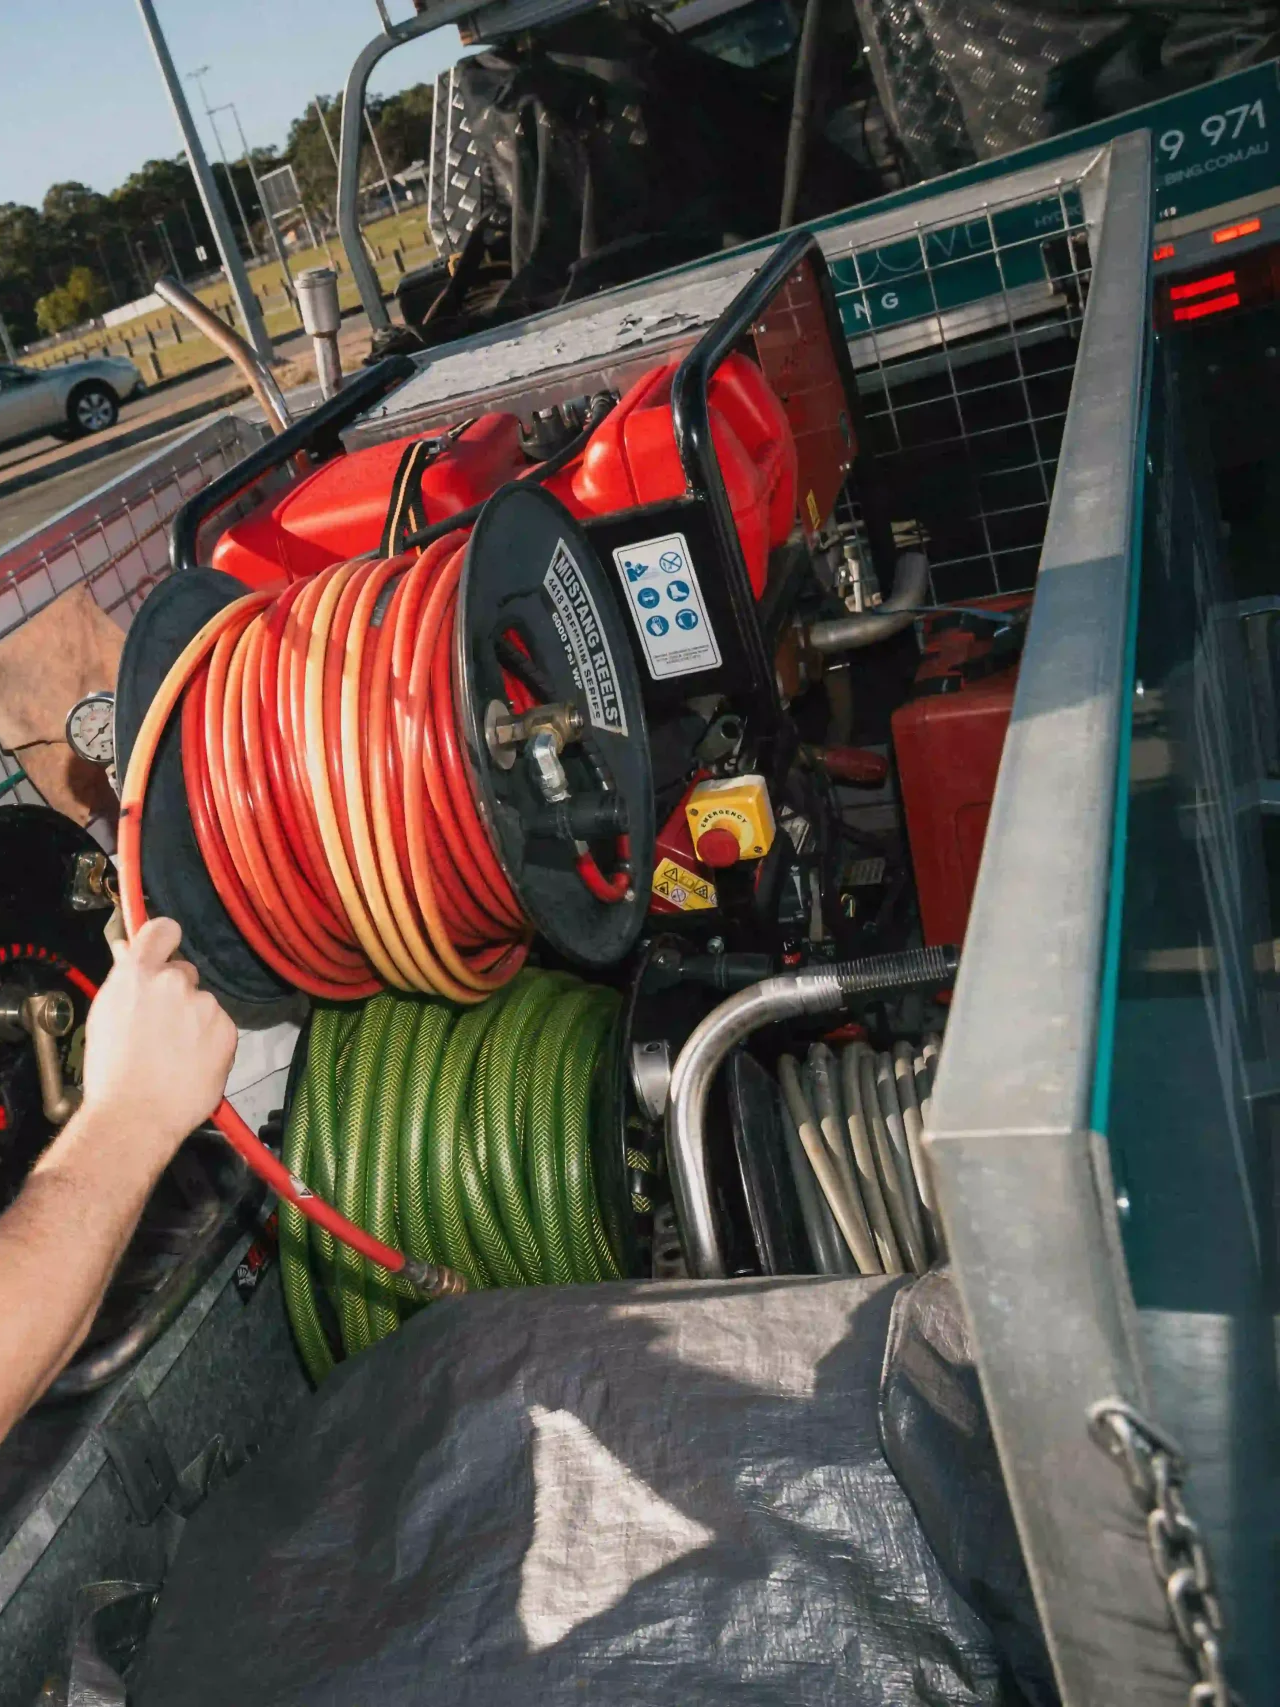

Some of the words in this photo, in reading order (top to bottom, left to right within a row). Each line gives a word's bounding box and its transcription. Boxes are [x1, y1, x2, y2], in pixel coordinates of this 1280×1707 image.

[1156, 130, 1185, 160] 9
[1201, 98, 1266, 146] 971
[1163, 141, 1269, 186] BING.COM.AU
[839, 292, 899, 323] ING
[548, 578, 564, 604] 4418
[562, 606, 588, 665] PREMIUM
[584, 670, 601, 719] SERIES
[552, 612, 567, 642] 6000
[571, 665, 583, 690] WP
[555, 555, 599, 648] MUSTANG
[592, 651, 618, 721] REELS
[701, 809, 747, 828] EMERGENCY
